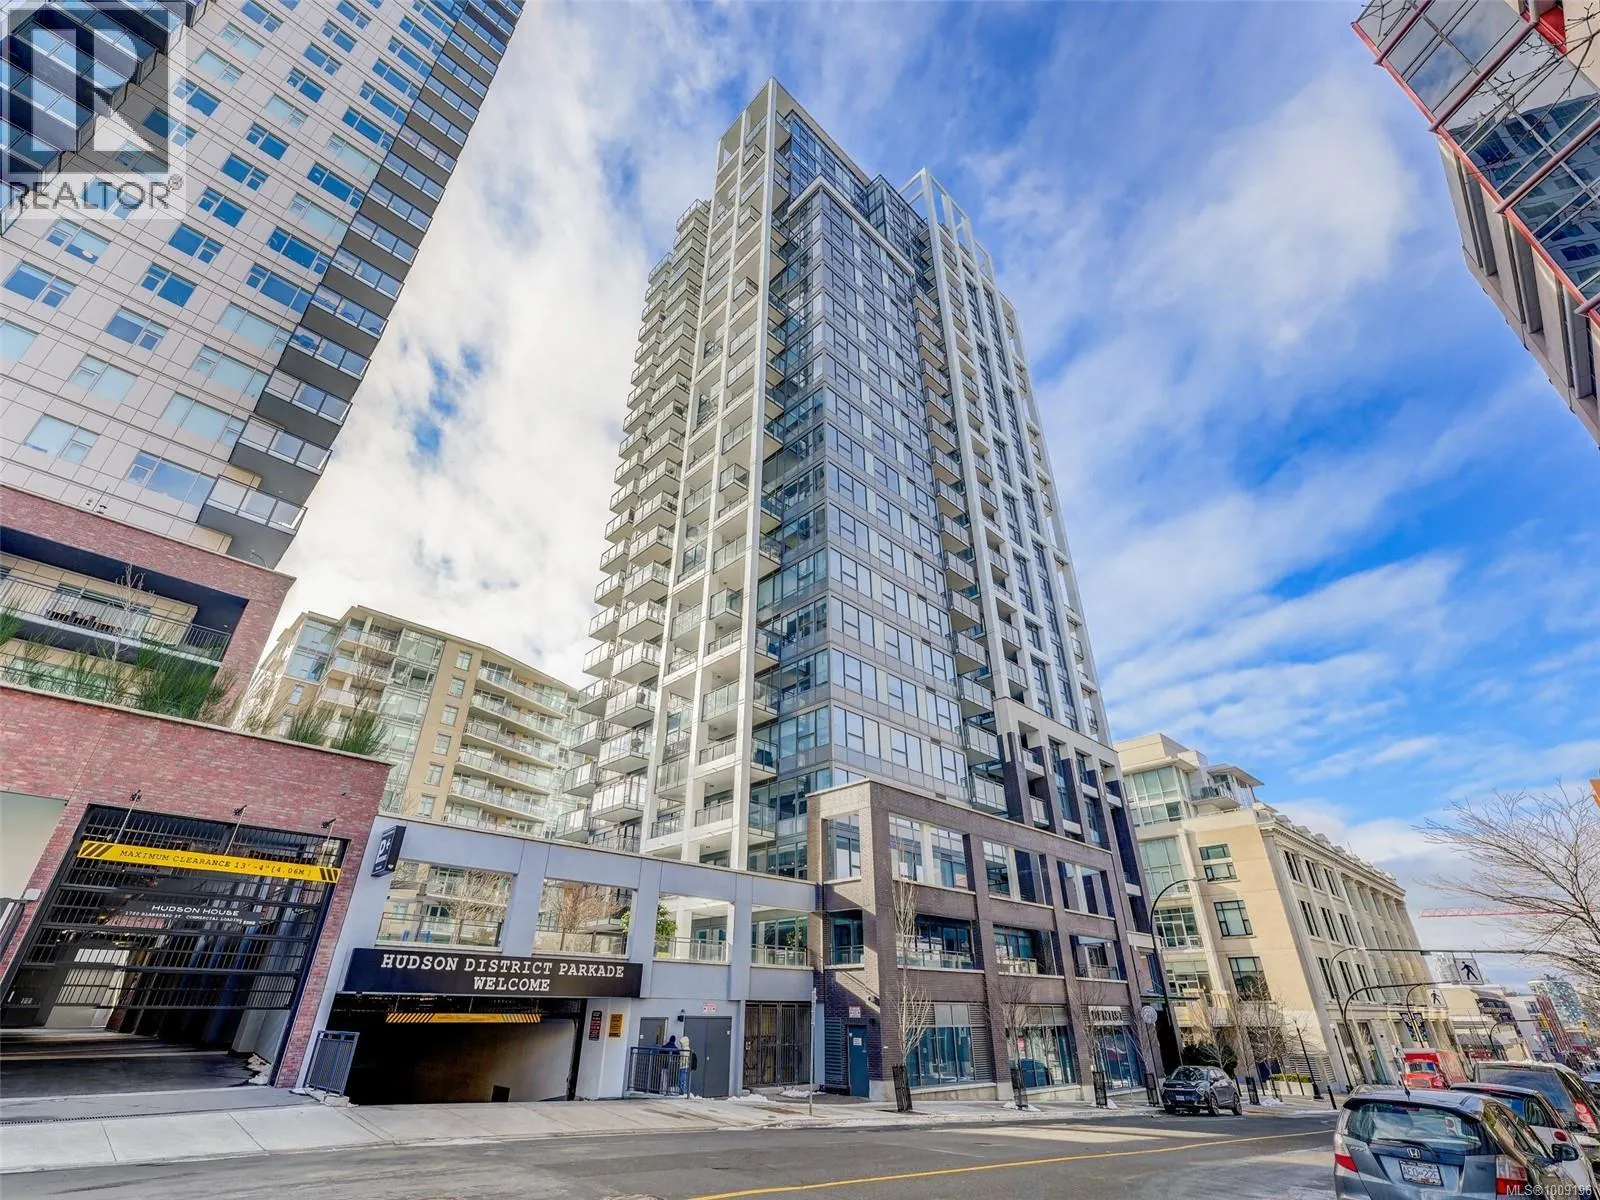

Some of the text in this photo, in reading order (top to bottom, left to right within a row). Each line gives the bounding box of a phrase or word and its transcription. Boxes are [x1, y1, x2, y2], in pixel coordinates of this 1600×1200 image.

[120, 850, 169, 861] MAXIMUM
[172, 855, 231, 868] CLEARANCE
[152, 904, 240, 916] HUDSON HOUSE
[381, 954, 625, 977] HUDSON DISTRICT PARKADE
[473, 976, 551, 991] WELCOME
